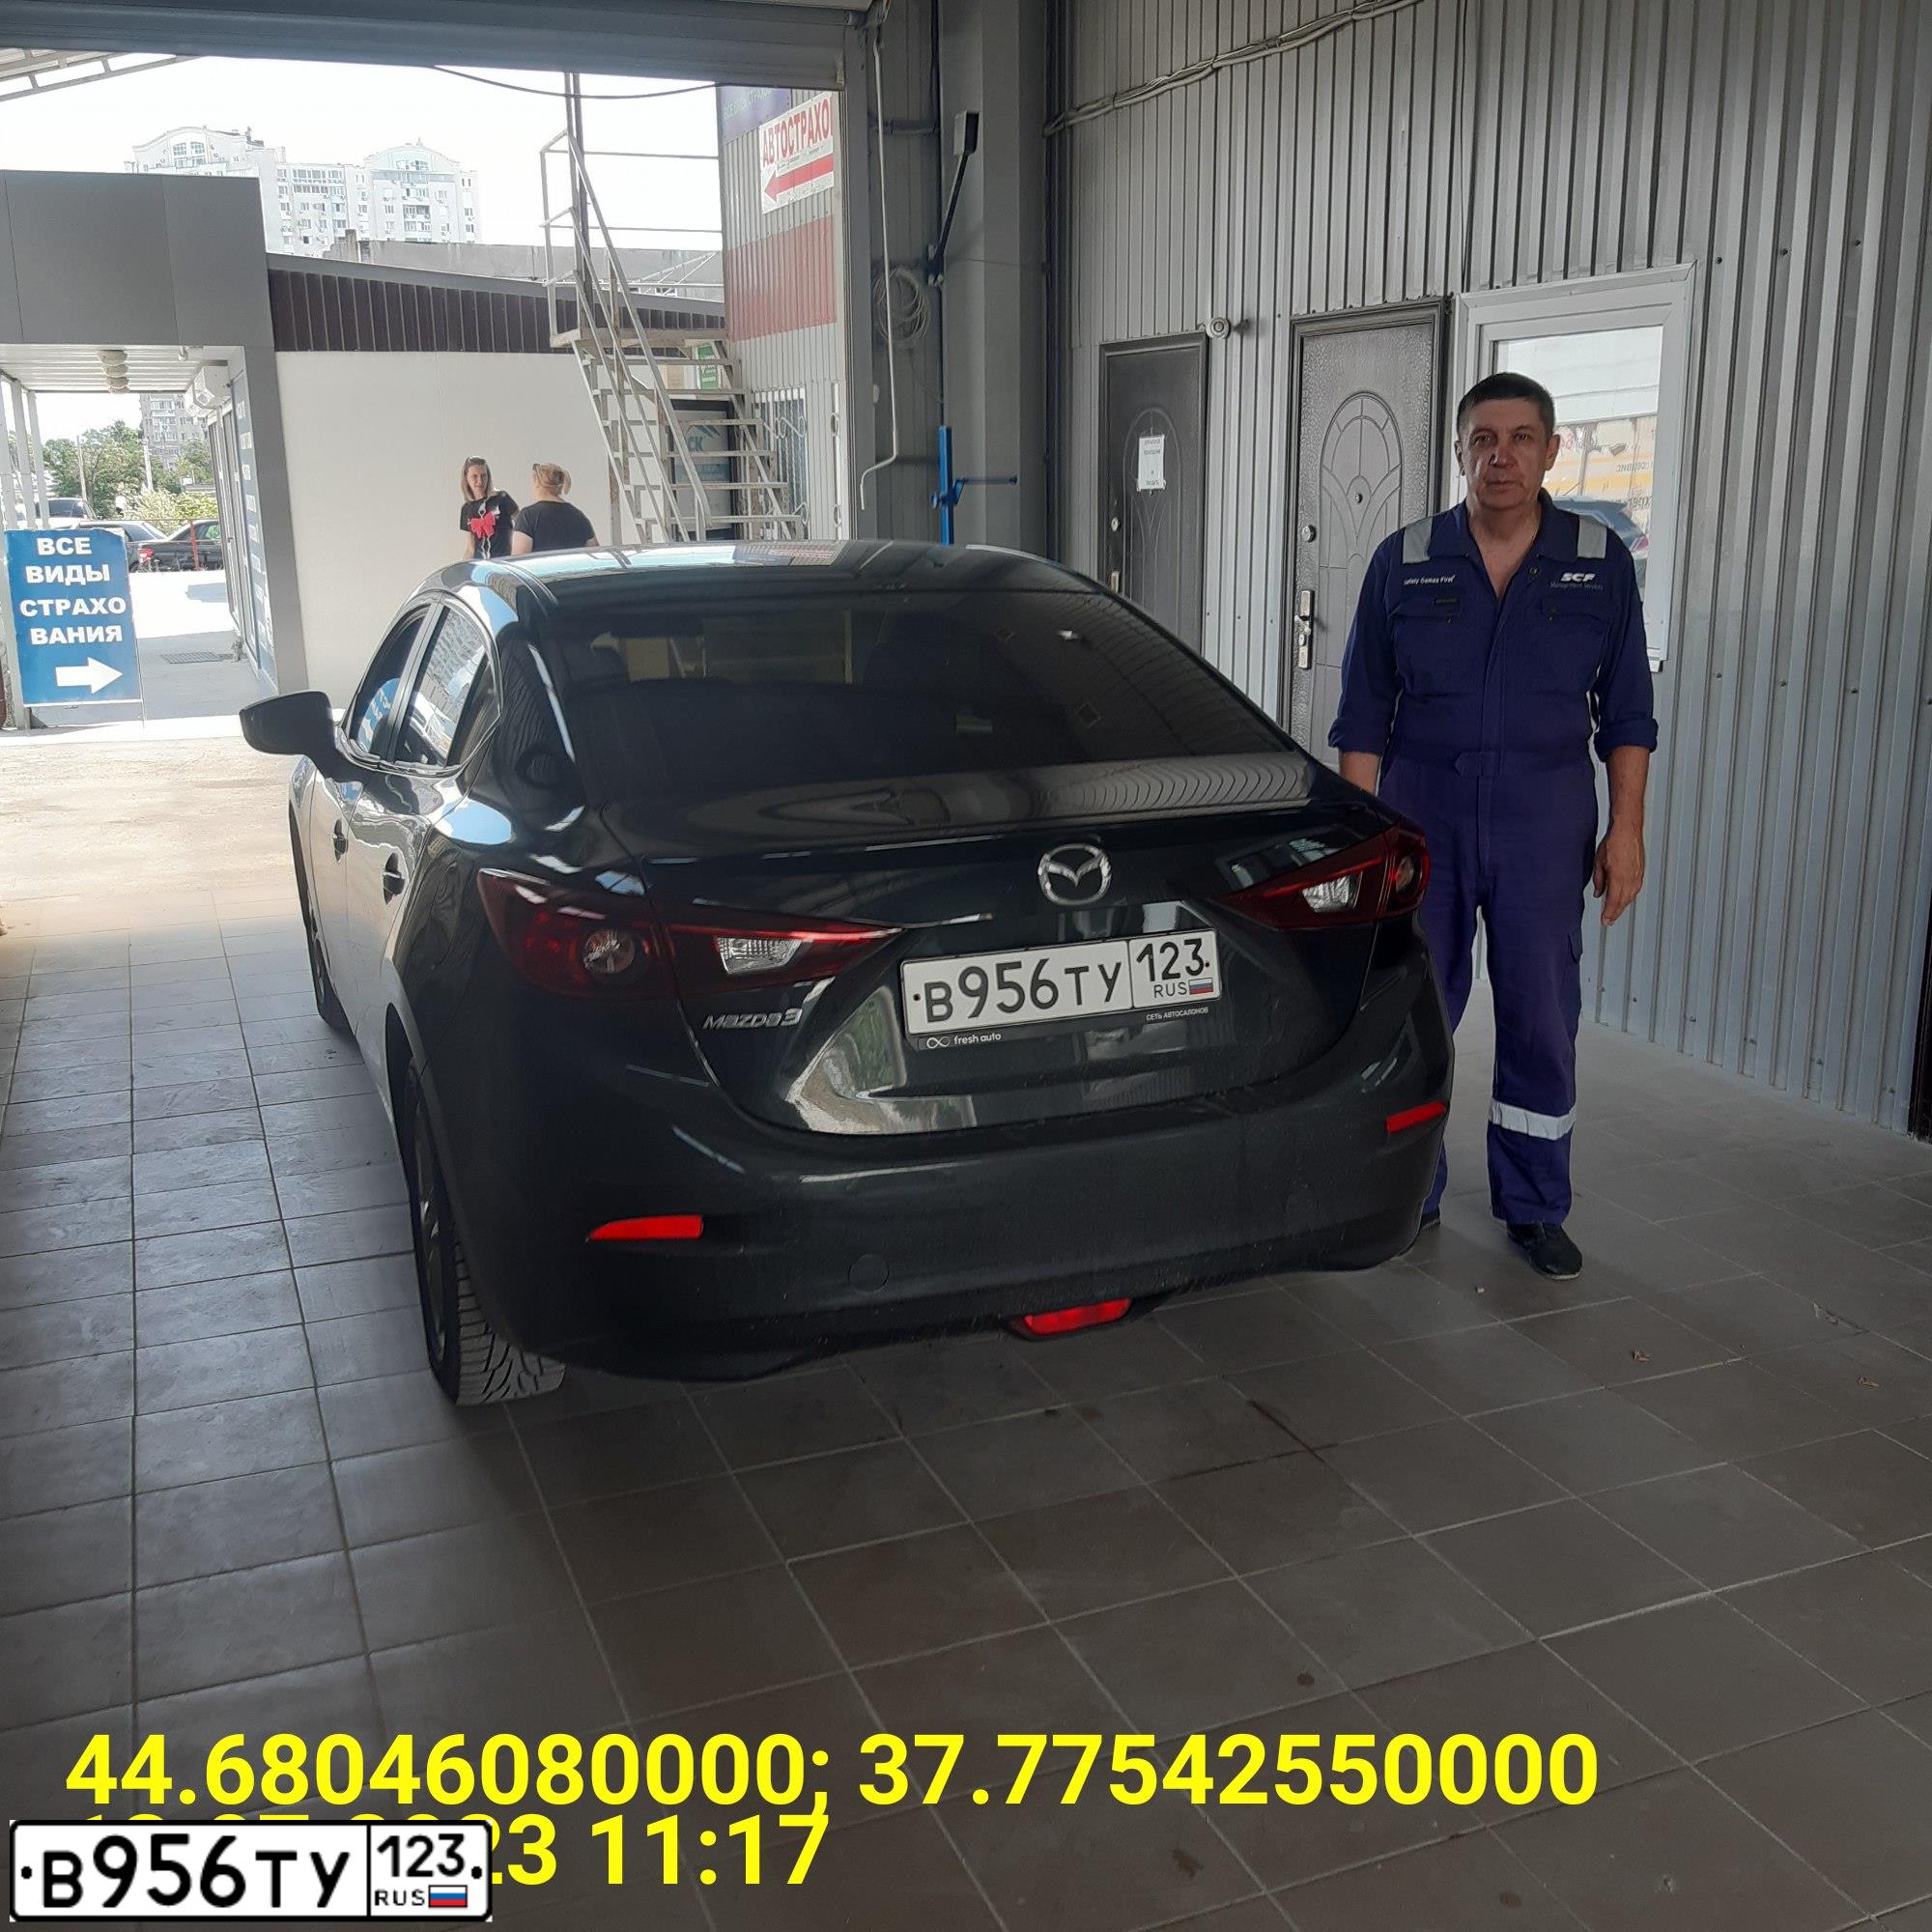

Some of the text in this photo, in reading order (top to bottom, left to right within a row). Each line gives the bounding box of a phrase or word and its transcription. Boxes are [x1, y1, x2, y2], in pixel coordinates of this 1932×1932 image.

[37, 537, 92, 555] ВСЕ
[25, 564, 111, 585] ВИДЫ
[1560, 572, 1597, 582] SCF
[19, 597, 127, 617] СТРАХО
[30, 625, 123, 645] ВАНИЯ
[923, 938, 1205, 1023] В956ТУ 123
[1153, 981, 1187, 999] RUS
[1163, 1007, 1209, 1019] АВТОСАЛОНОВ
[953, 1033, 1002, 1045] fresh auto
